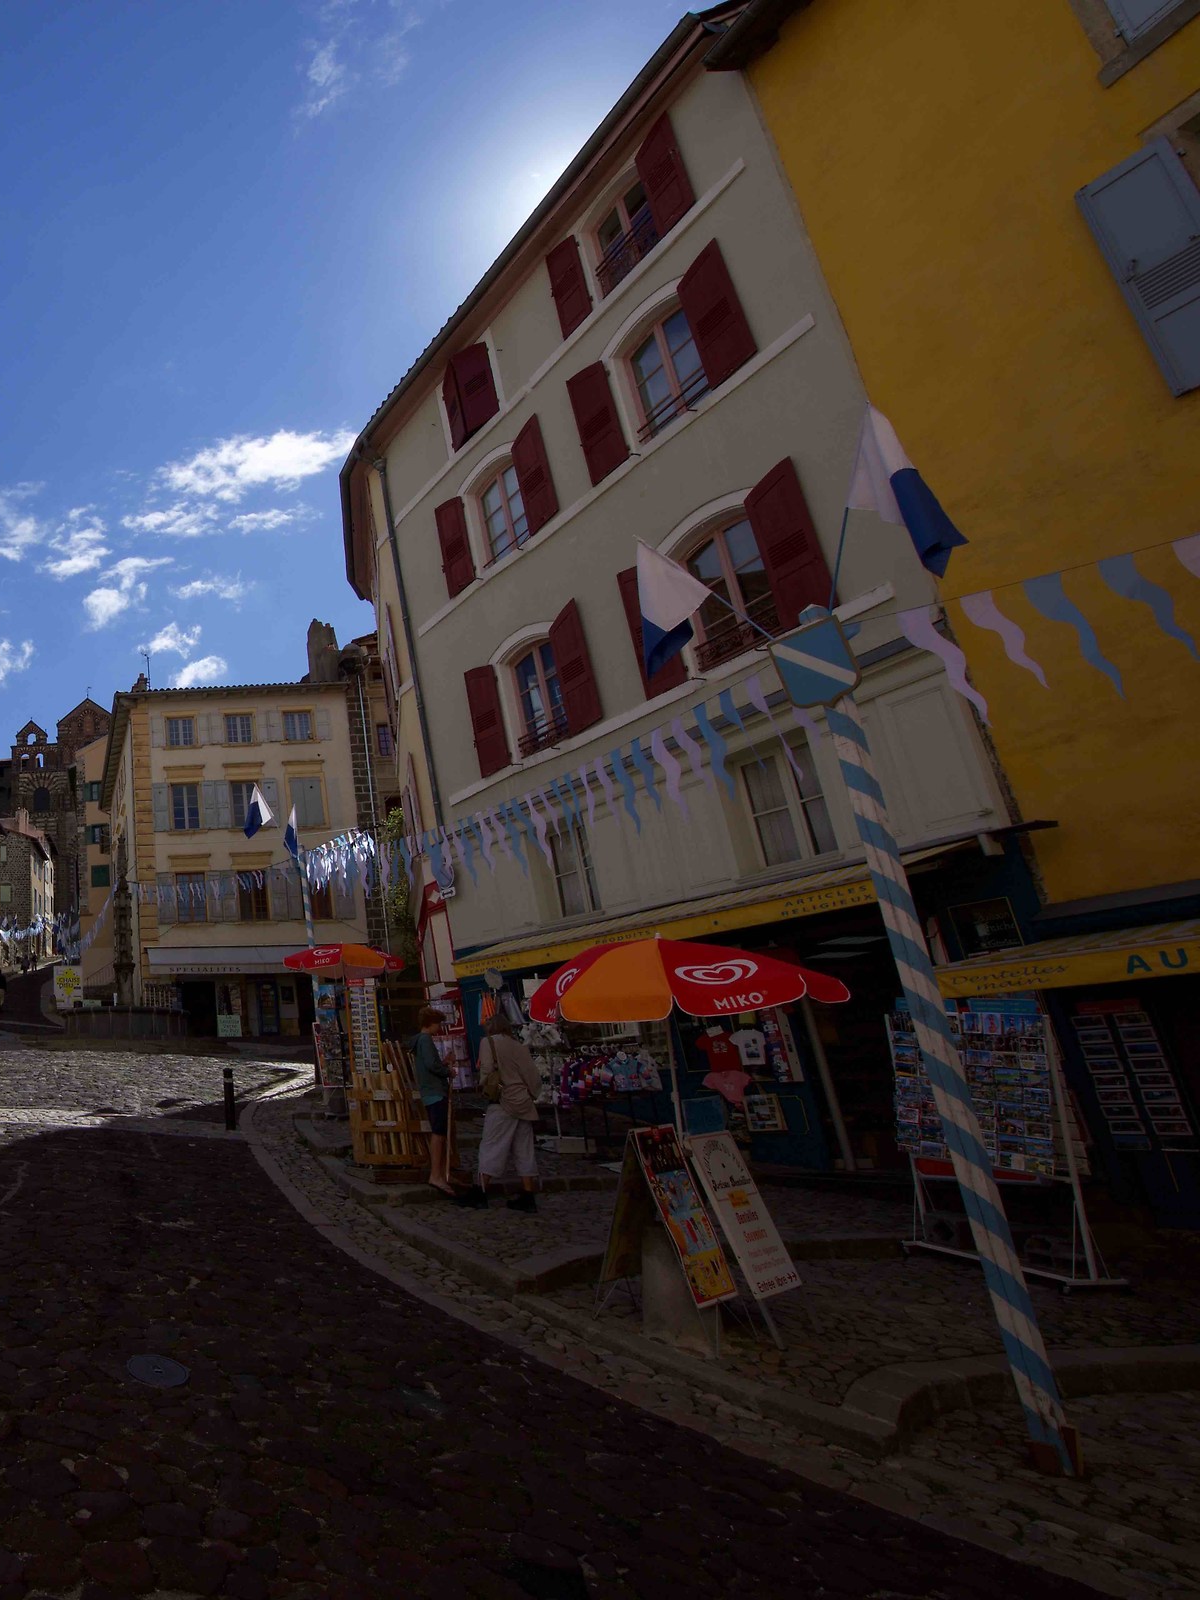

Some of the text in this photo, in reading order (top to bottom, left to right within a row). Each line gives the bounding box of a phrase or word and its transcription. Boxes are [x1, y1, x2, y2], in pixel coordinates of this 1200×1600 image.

[781, 894, 873, 917] RELIGIEUX
[784, 885, 872, 907] ARTICLES
[595, 930, 651, 945] PRODUITS
[1126, 947, 1189, 974] AU
[951, 964, 1069, 985] Dentelles
[713, 992, 764, 1010] MIKO
